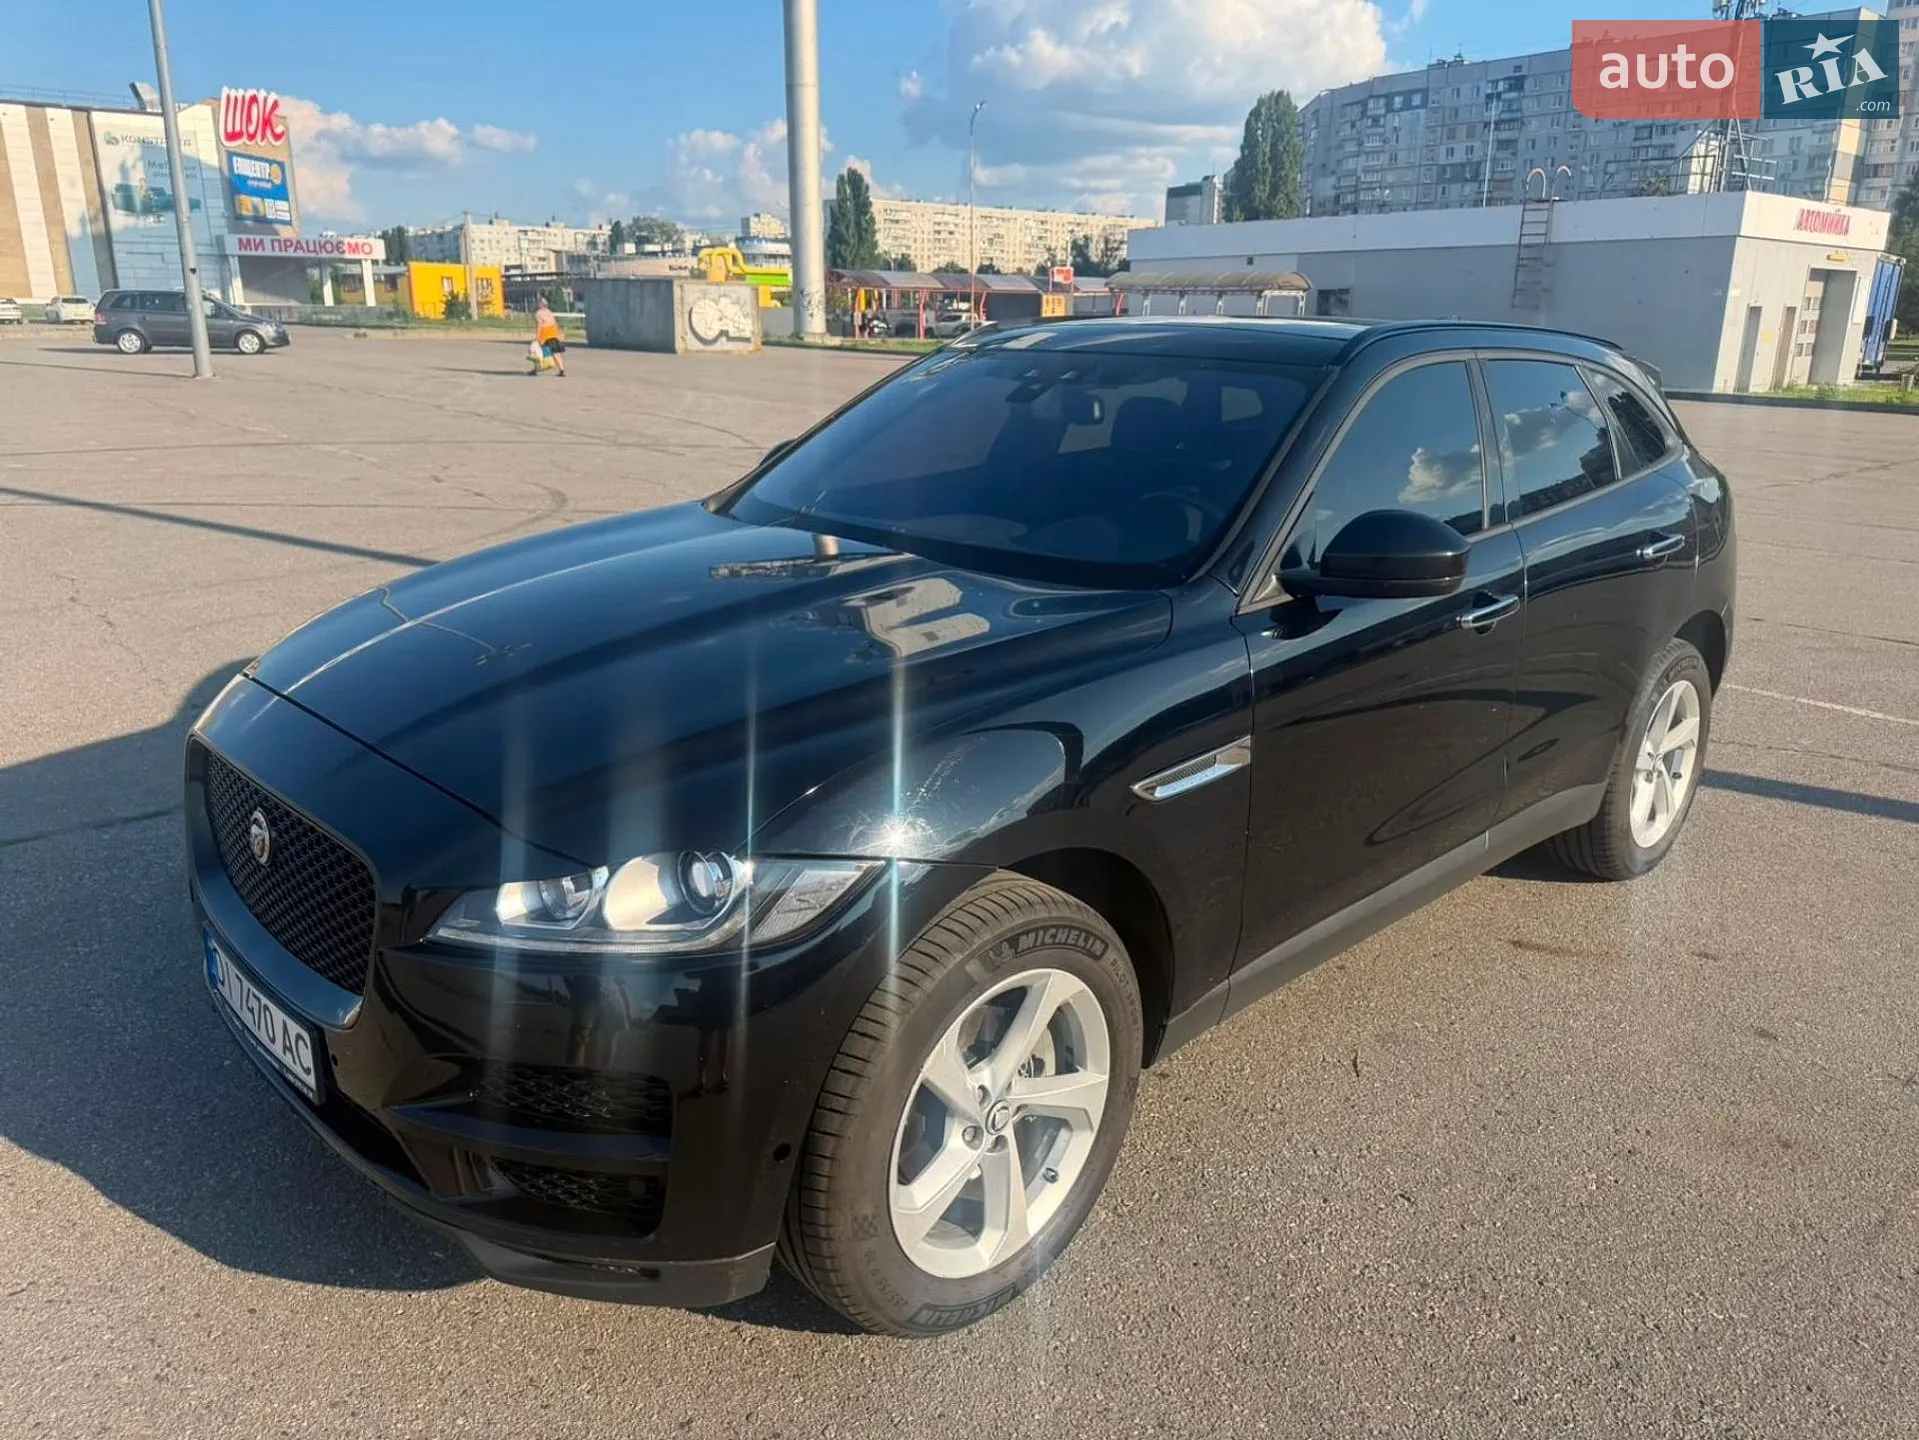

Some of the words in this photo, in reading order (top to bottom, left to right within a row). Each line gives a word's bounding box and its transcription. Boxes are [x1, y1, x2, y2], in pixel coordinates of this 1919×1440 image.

[221, 89, 286, 145] ШОК
[238, 237, 265, 252] МИ
[271, 238, 373, 256] ПРАЦЮЄМО
[1018, 928, 1106, 956] MICHELIN
[236, 974, 276, 1045] 7470
[282, 1019, 312, 1076] AC
